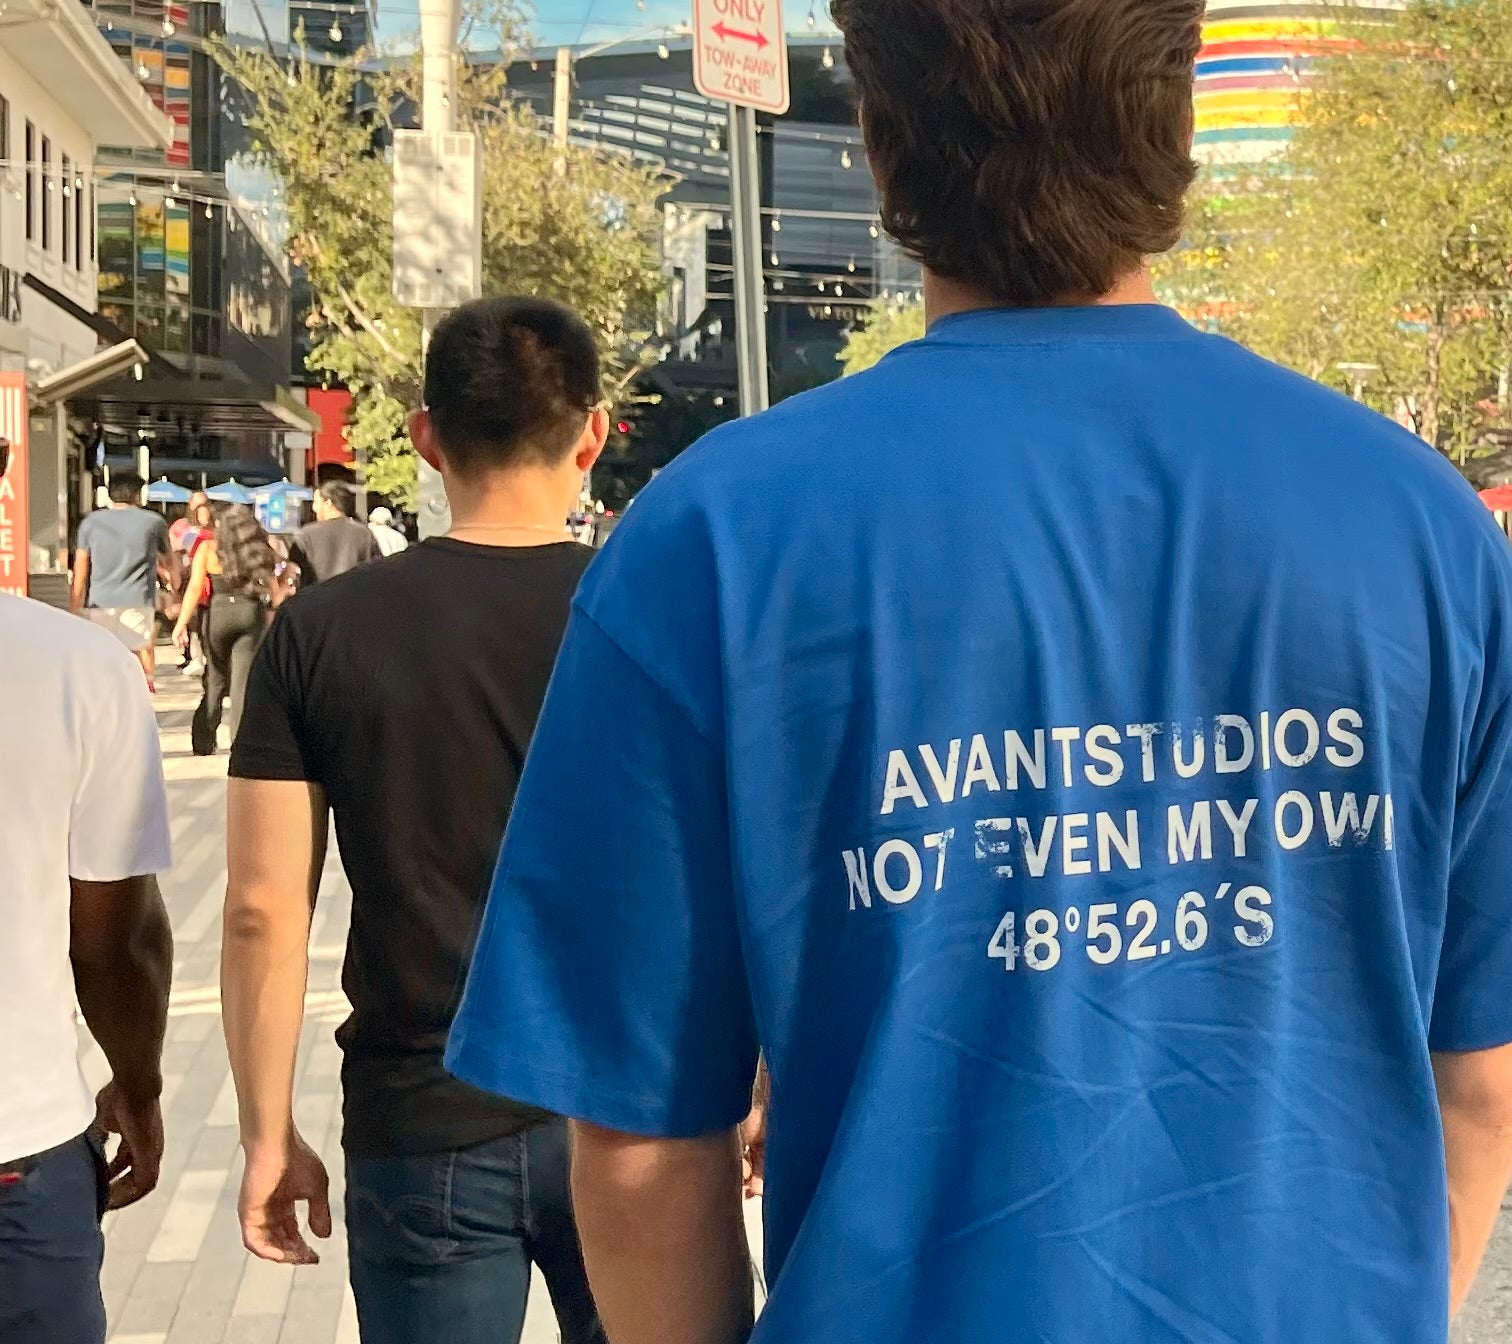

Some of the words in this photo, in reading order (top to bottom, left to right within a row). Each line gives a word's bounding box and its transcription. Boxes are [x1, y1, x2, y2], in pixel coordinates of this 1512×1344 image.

[704, 45, 776, 79] TOW-AWAY
[723, 71, 761, 96] ZONE
[0, 452, 15, 576] ALET
[880, 708, 1364, 814] AVANTSTUDIOS
[842, 827, 954, 910] NOT
[975, 810, 1141, 878] EVEN
[1167, 798, 1259, 864] MY
